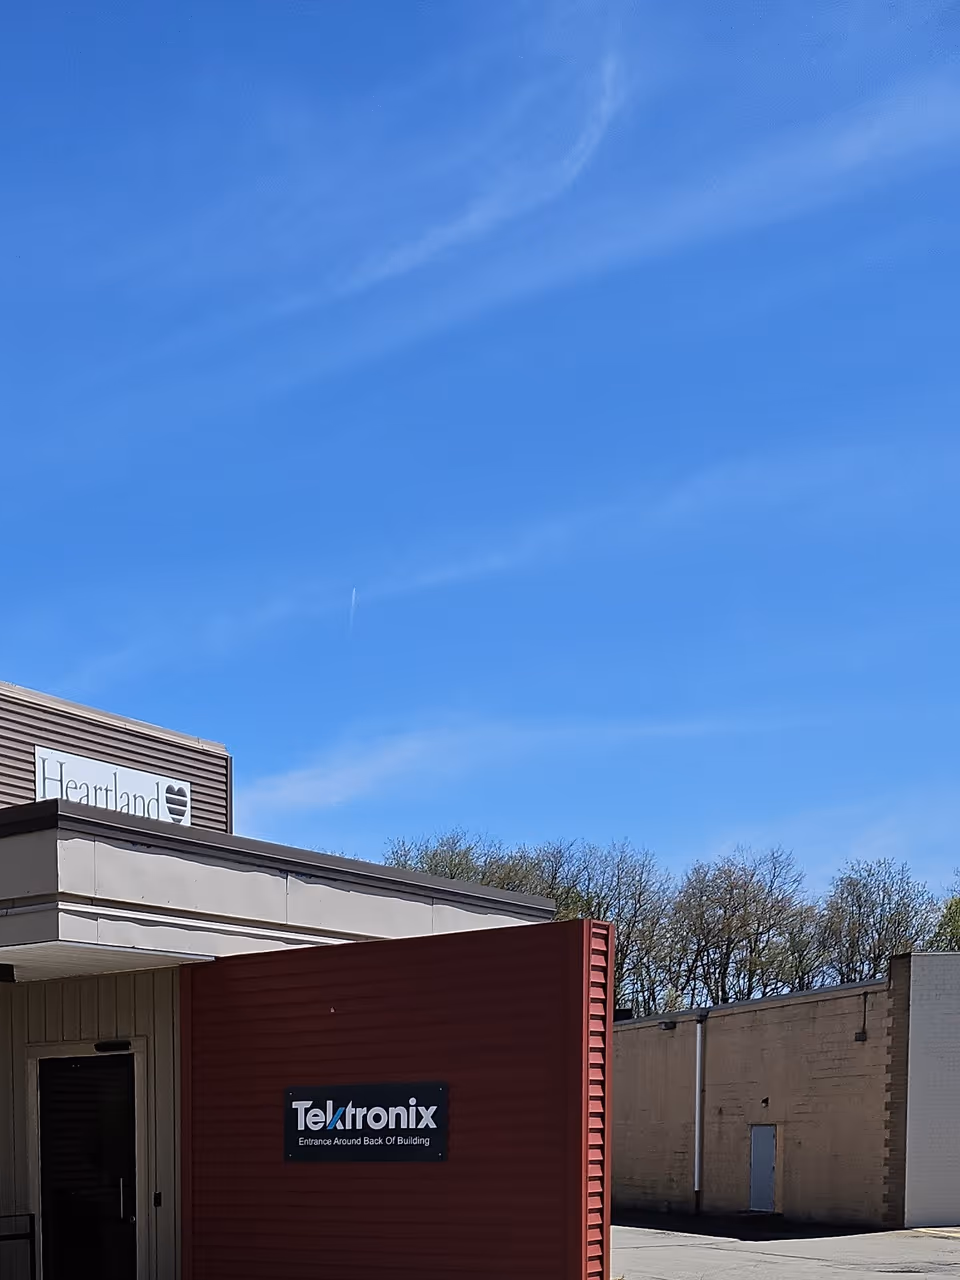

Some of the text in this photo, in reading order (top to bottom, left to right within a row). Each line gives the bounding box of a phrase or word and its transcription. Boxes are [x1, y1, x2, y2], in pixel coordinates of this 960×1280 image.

[39, 756, 160, 820] Heartland
[292, 1097, 438, 1131] Tektronix
[298, 1136, 430, 1147] Entrance Around Back Of Building
